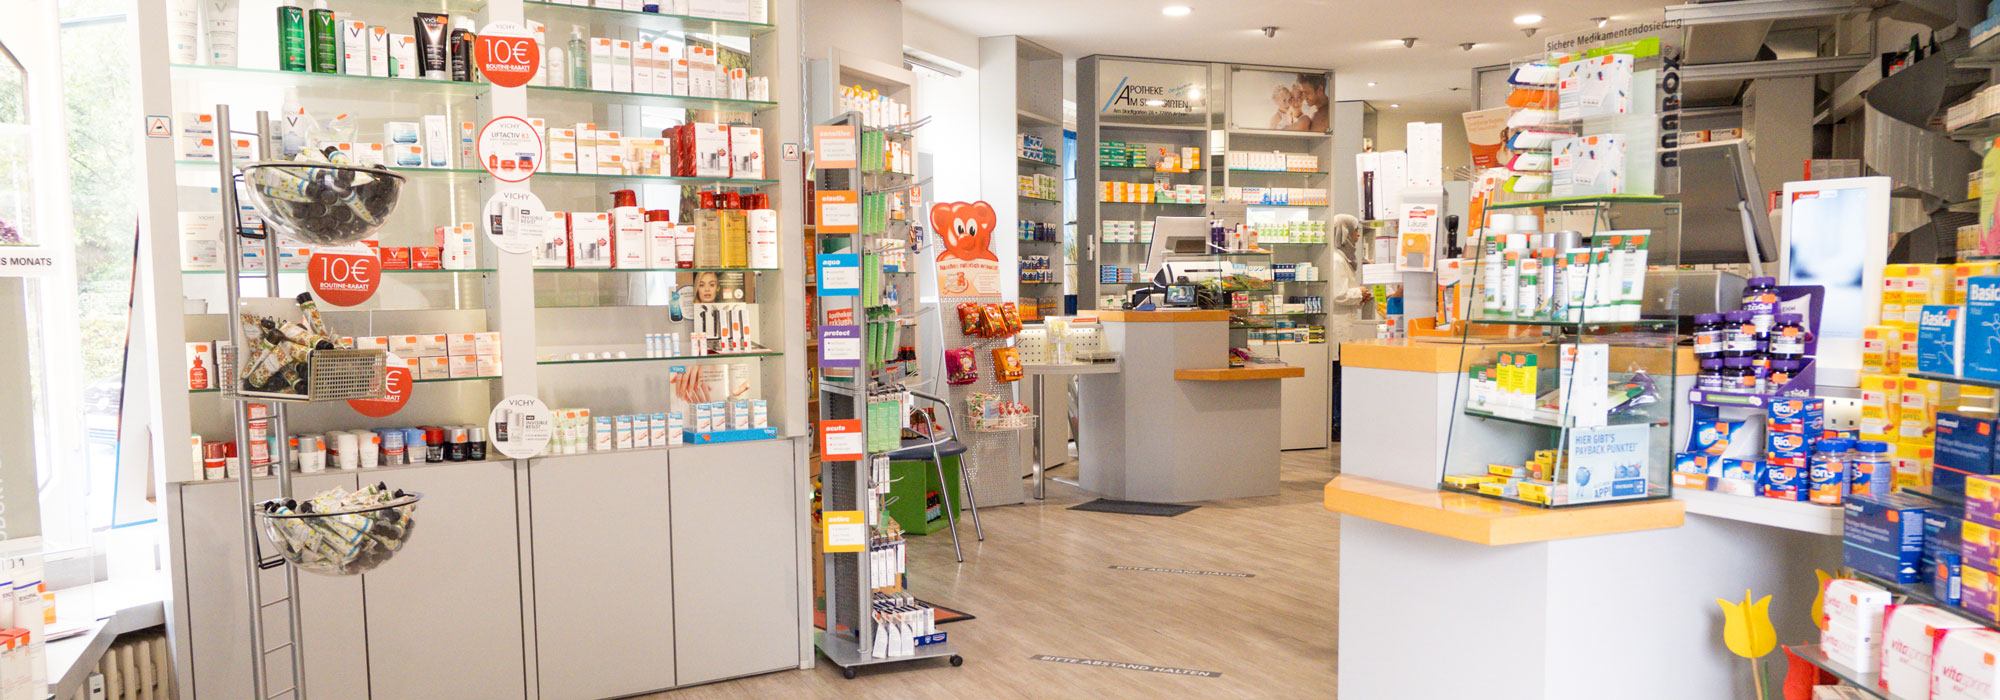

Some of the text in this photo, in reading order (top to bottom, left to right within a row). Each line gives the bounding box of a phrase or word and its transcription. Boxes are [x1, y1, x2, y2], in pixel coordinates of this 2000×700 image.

[1547, 18, 1683, 52] Sichere Medikamentendosierung
[484, 38, 530, 64] 10€
[485, 63, 531, 71] ROUTINE-RABATT
[503, 192, 530, 200] VICHY
[821, 194, 846, 202] elastic
[9, 257, 52, 266] MONATS
[822, 258, 841, 266] aqua
[320, 256, 370, 284] 10€
[320, 282, 369, 290] ROUTINE-RABATT
[1921, 310, 1951, 327] Basica
[823, 329, 851, 338] protect
[508, 399, 536, 407] VICHY
[1575, 433, 1616, 445] HIER GIBT'S
[1575, 445, 1605, 455] PAYBACK
[1081, 659, 1150, 671] ABSTAND
[1152, 667, 1211, 676] HALTEN
